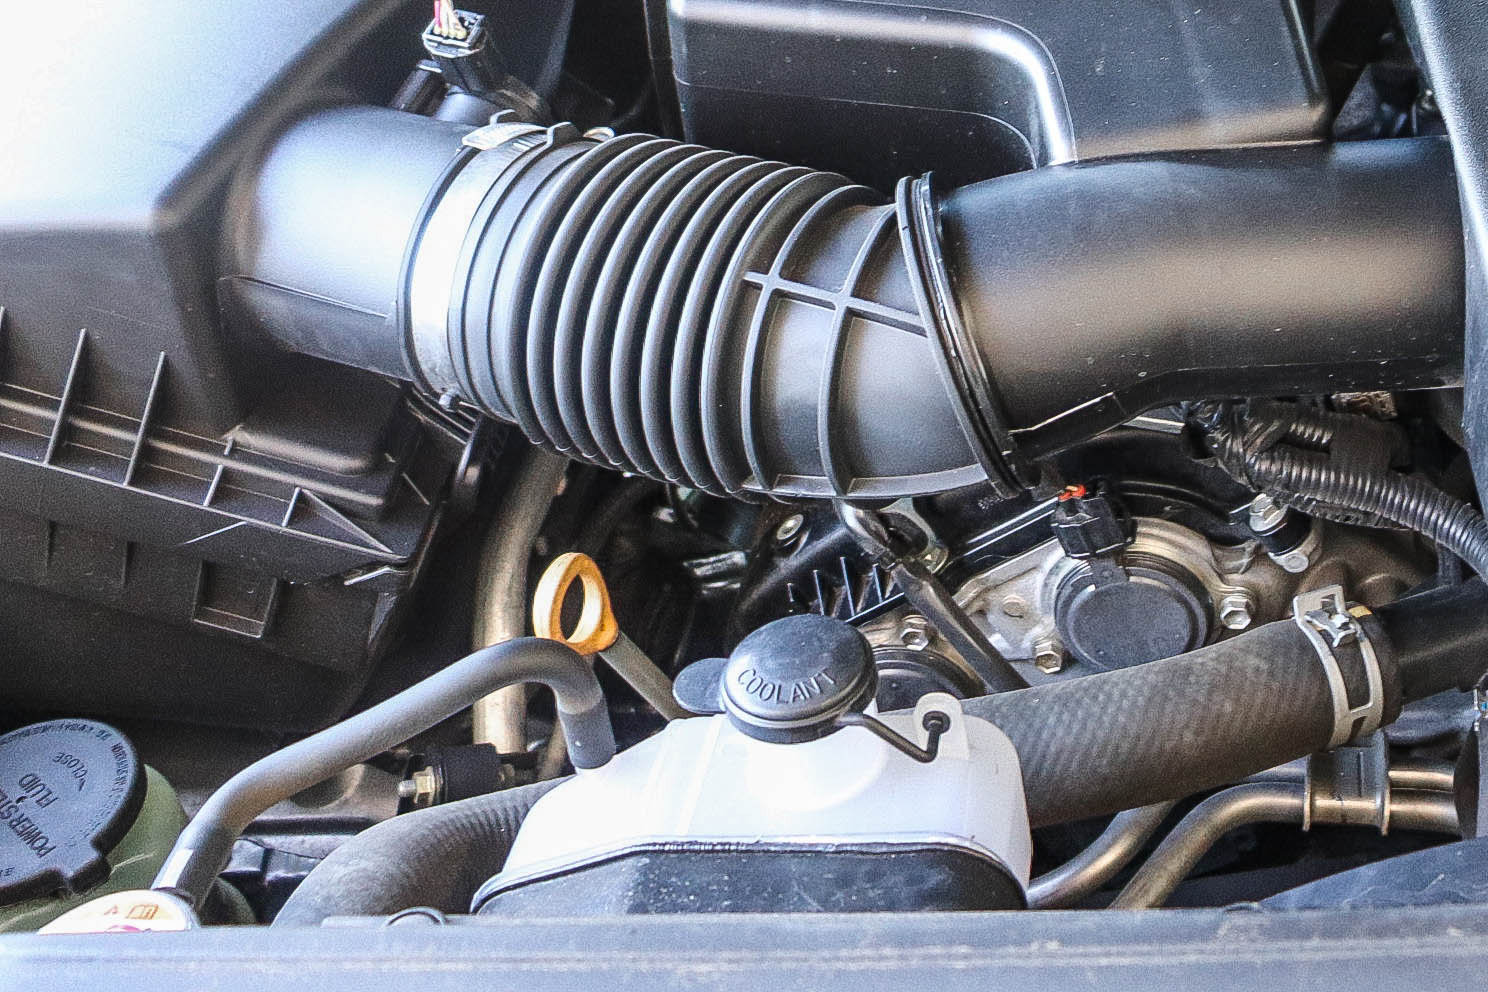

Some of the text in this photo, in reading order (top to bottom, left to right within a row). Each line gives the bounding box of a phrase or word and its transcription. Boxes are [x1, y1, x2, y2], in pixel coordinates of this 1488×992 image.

[737, 667, 836, 704] COOLANT
[51, 751, 86, 781] CLOSE
[18, 772, 59, 810] FLUID
[7, 812, 56, 858] POWER
